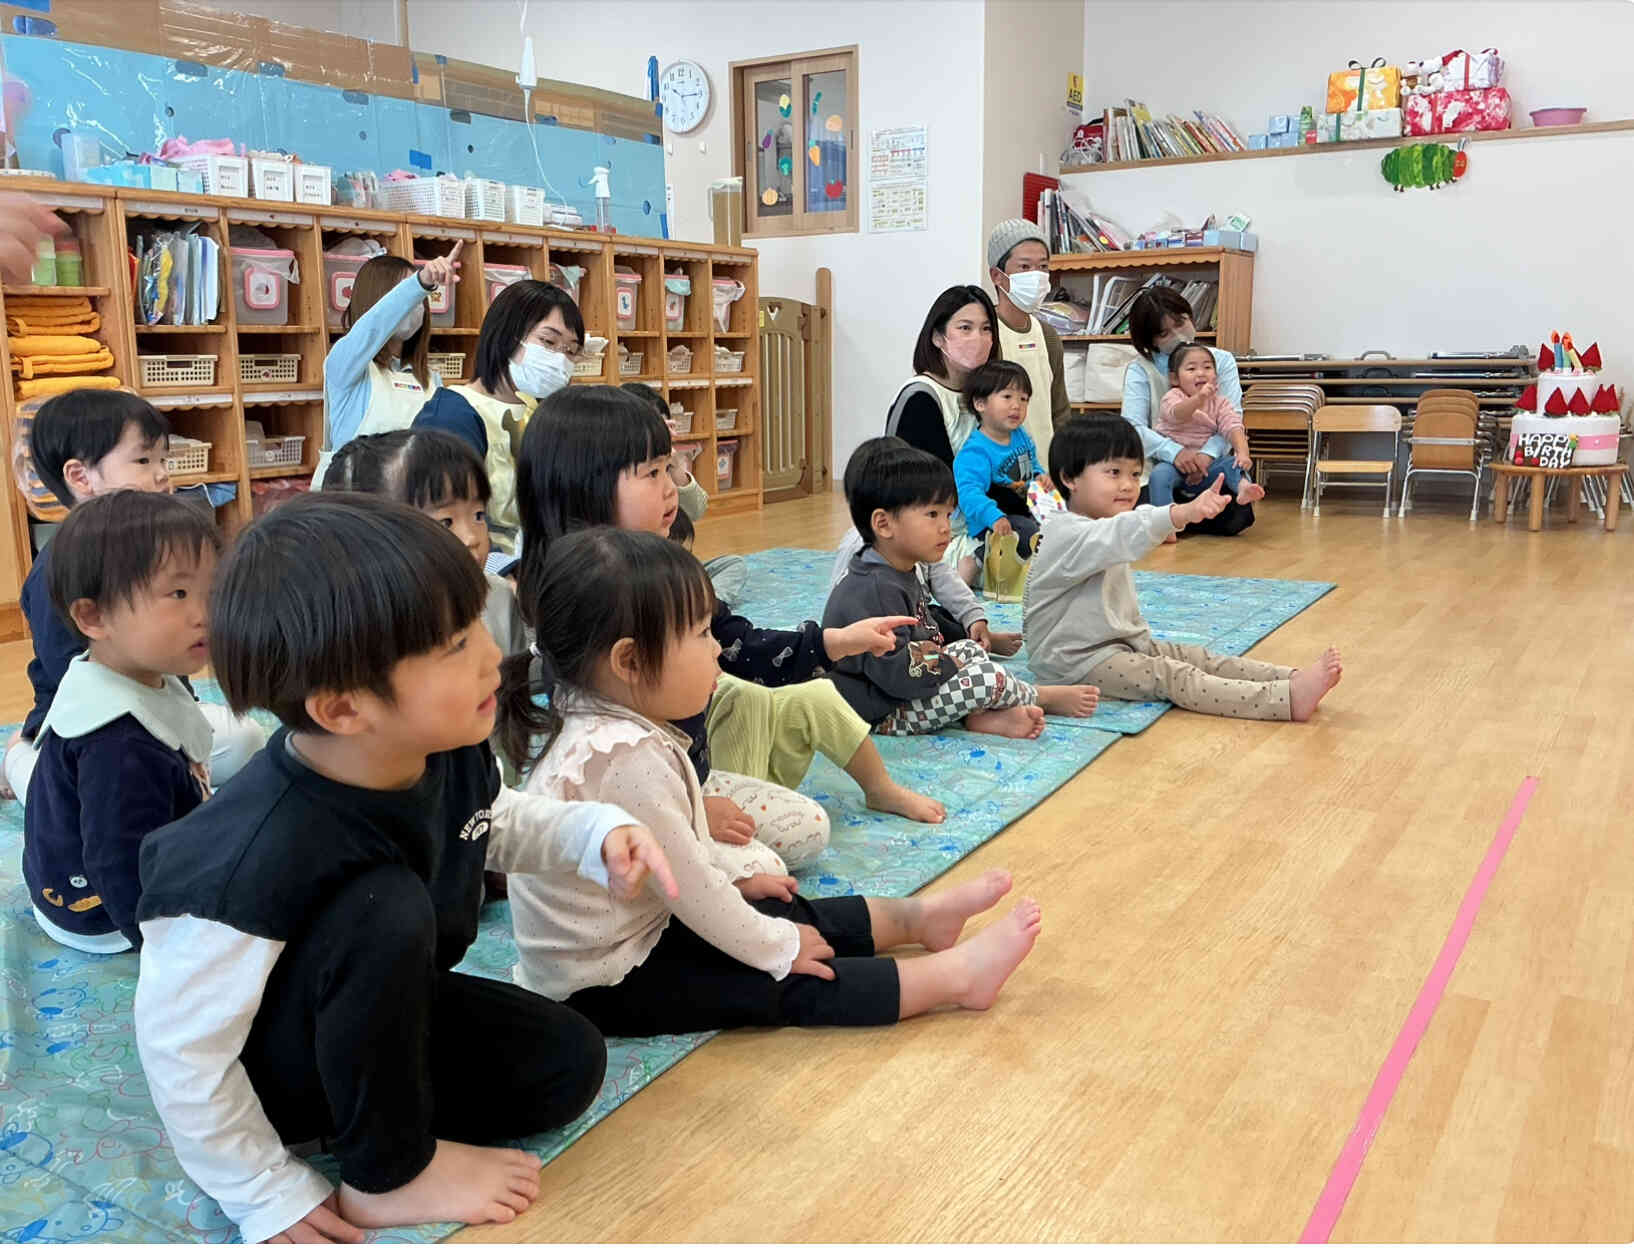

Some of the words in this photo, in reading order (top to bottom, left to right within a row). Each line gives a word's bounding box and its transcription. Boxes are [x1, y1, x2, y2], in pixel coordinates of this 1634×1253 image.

[1066, 88, 1081, 103] AED
[1524, 445, 1572, 459] BIRTH
[1540, 455, 1570, 468] DAY
